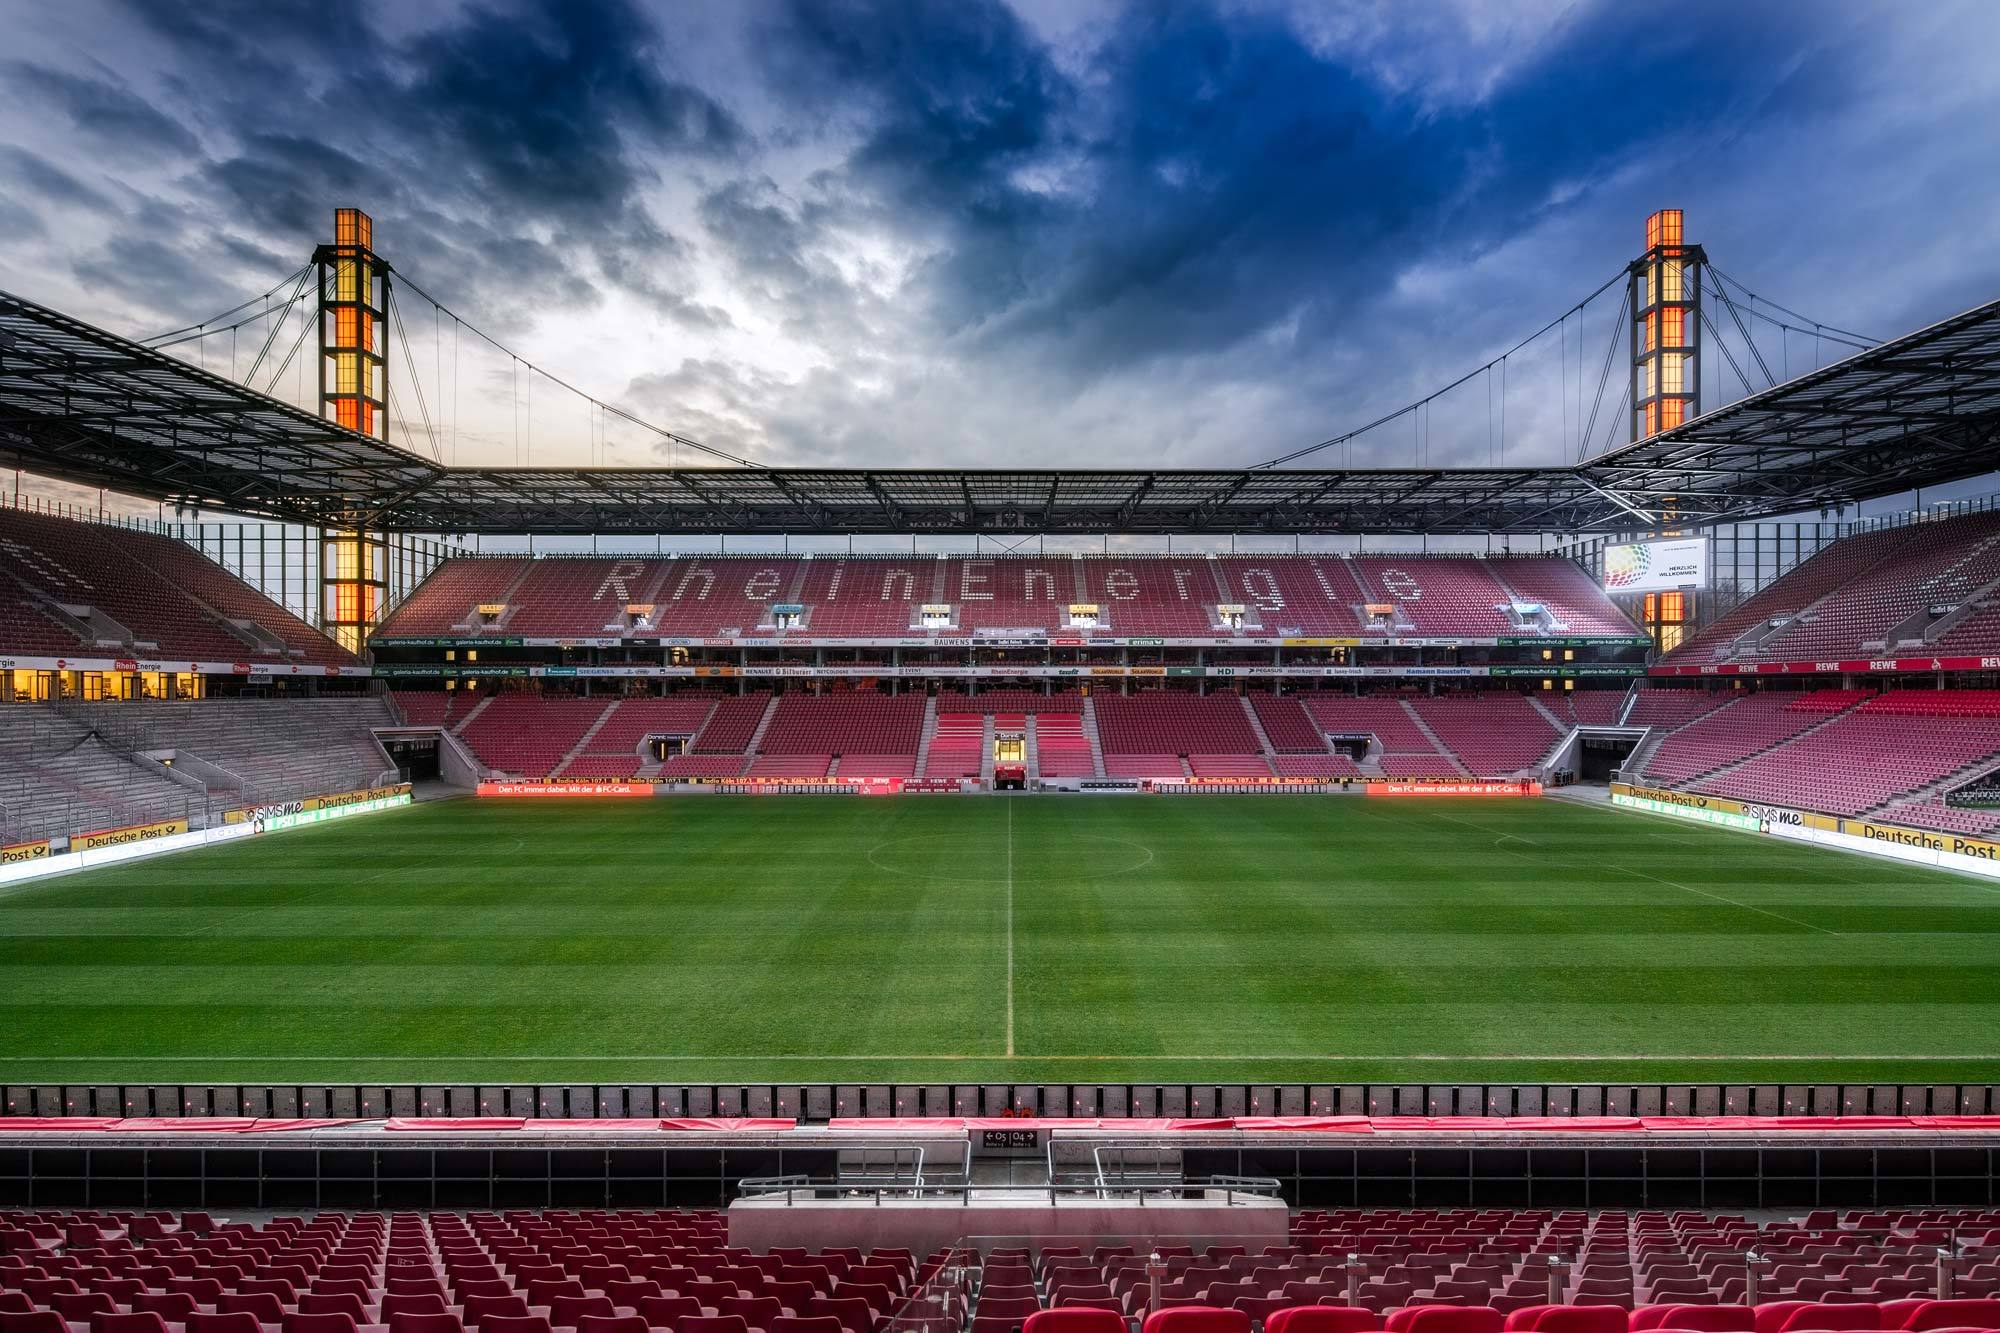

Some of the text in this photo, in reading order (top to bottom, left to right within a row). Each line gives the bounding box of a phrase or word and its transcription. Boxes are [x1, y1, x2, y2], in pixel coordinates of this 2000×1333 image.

[388, 639, 435, 647] galeria-kaufhof.de
[455, 639, 502, 647] galeria-kaufhof.de
[934, 638, 970, 646] BAUWENS
[115, 660, 161, 671] RheinEnergie
[233, 664, 269, 674] RheinEnergie
[1738, 664, 1759, 673] REWE
[1815, 662, 1840, 672] REWE
[1869, 660, 1897, 671] REWE
[393, 668, 441, 676] galeria-kaufhof.de
[461, 668, 509, 676] galeria-kaufhof.de
[1510, 668, 1558, 676] galeria-kaufhof.de
[1579, 668, 1627, 676] galeria-kaufhof.de
[318, 789, 386, 810] Deutsche Post
[1629, 787, 1693, 807] Deutsche Post
[256, 801, 304, 821] SIMSme
[1751, 805, 1802, 826] SIMSme
[87, 827, 162, 848] Deutsche Post
[1864, 825, 1996, 860] Deutsche Post
[2, 850, 30, 863] Post
